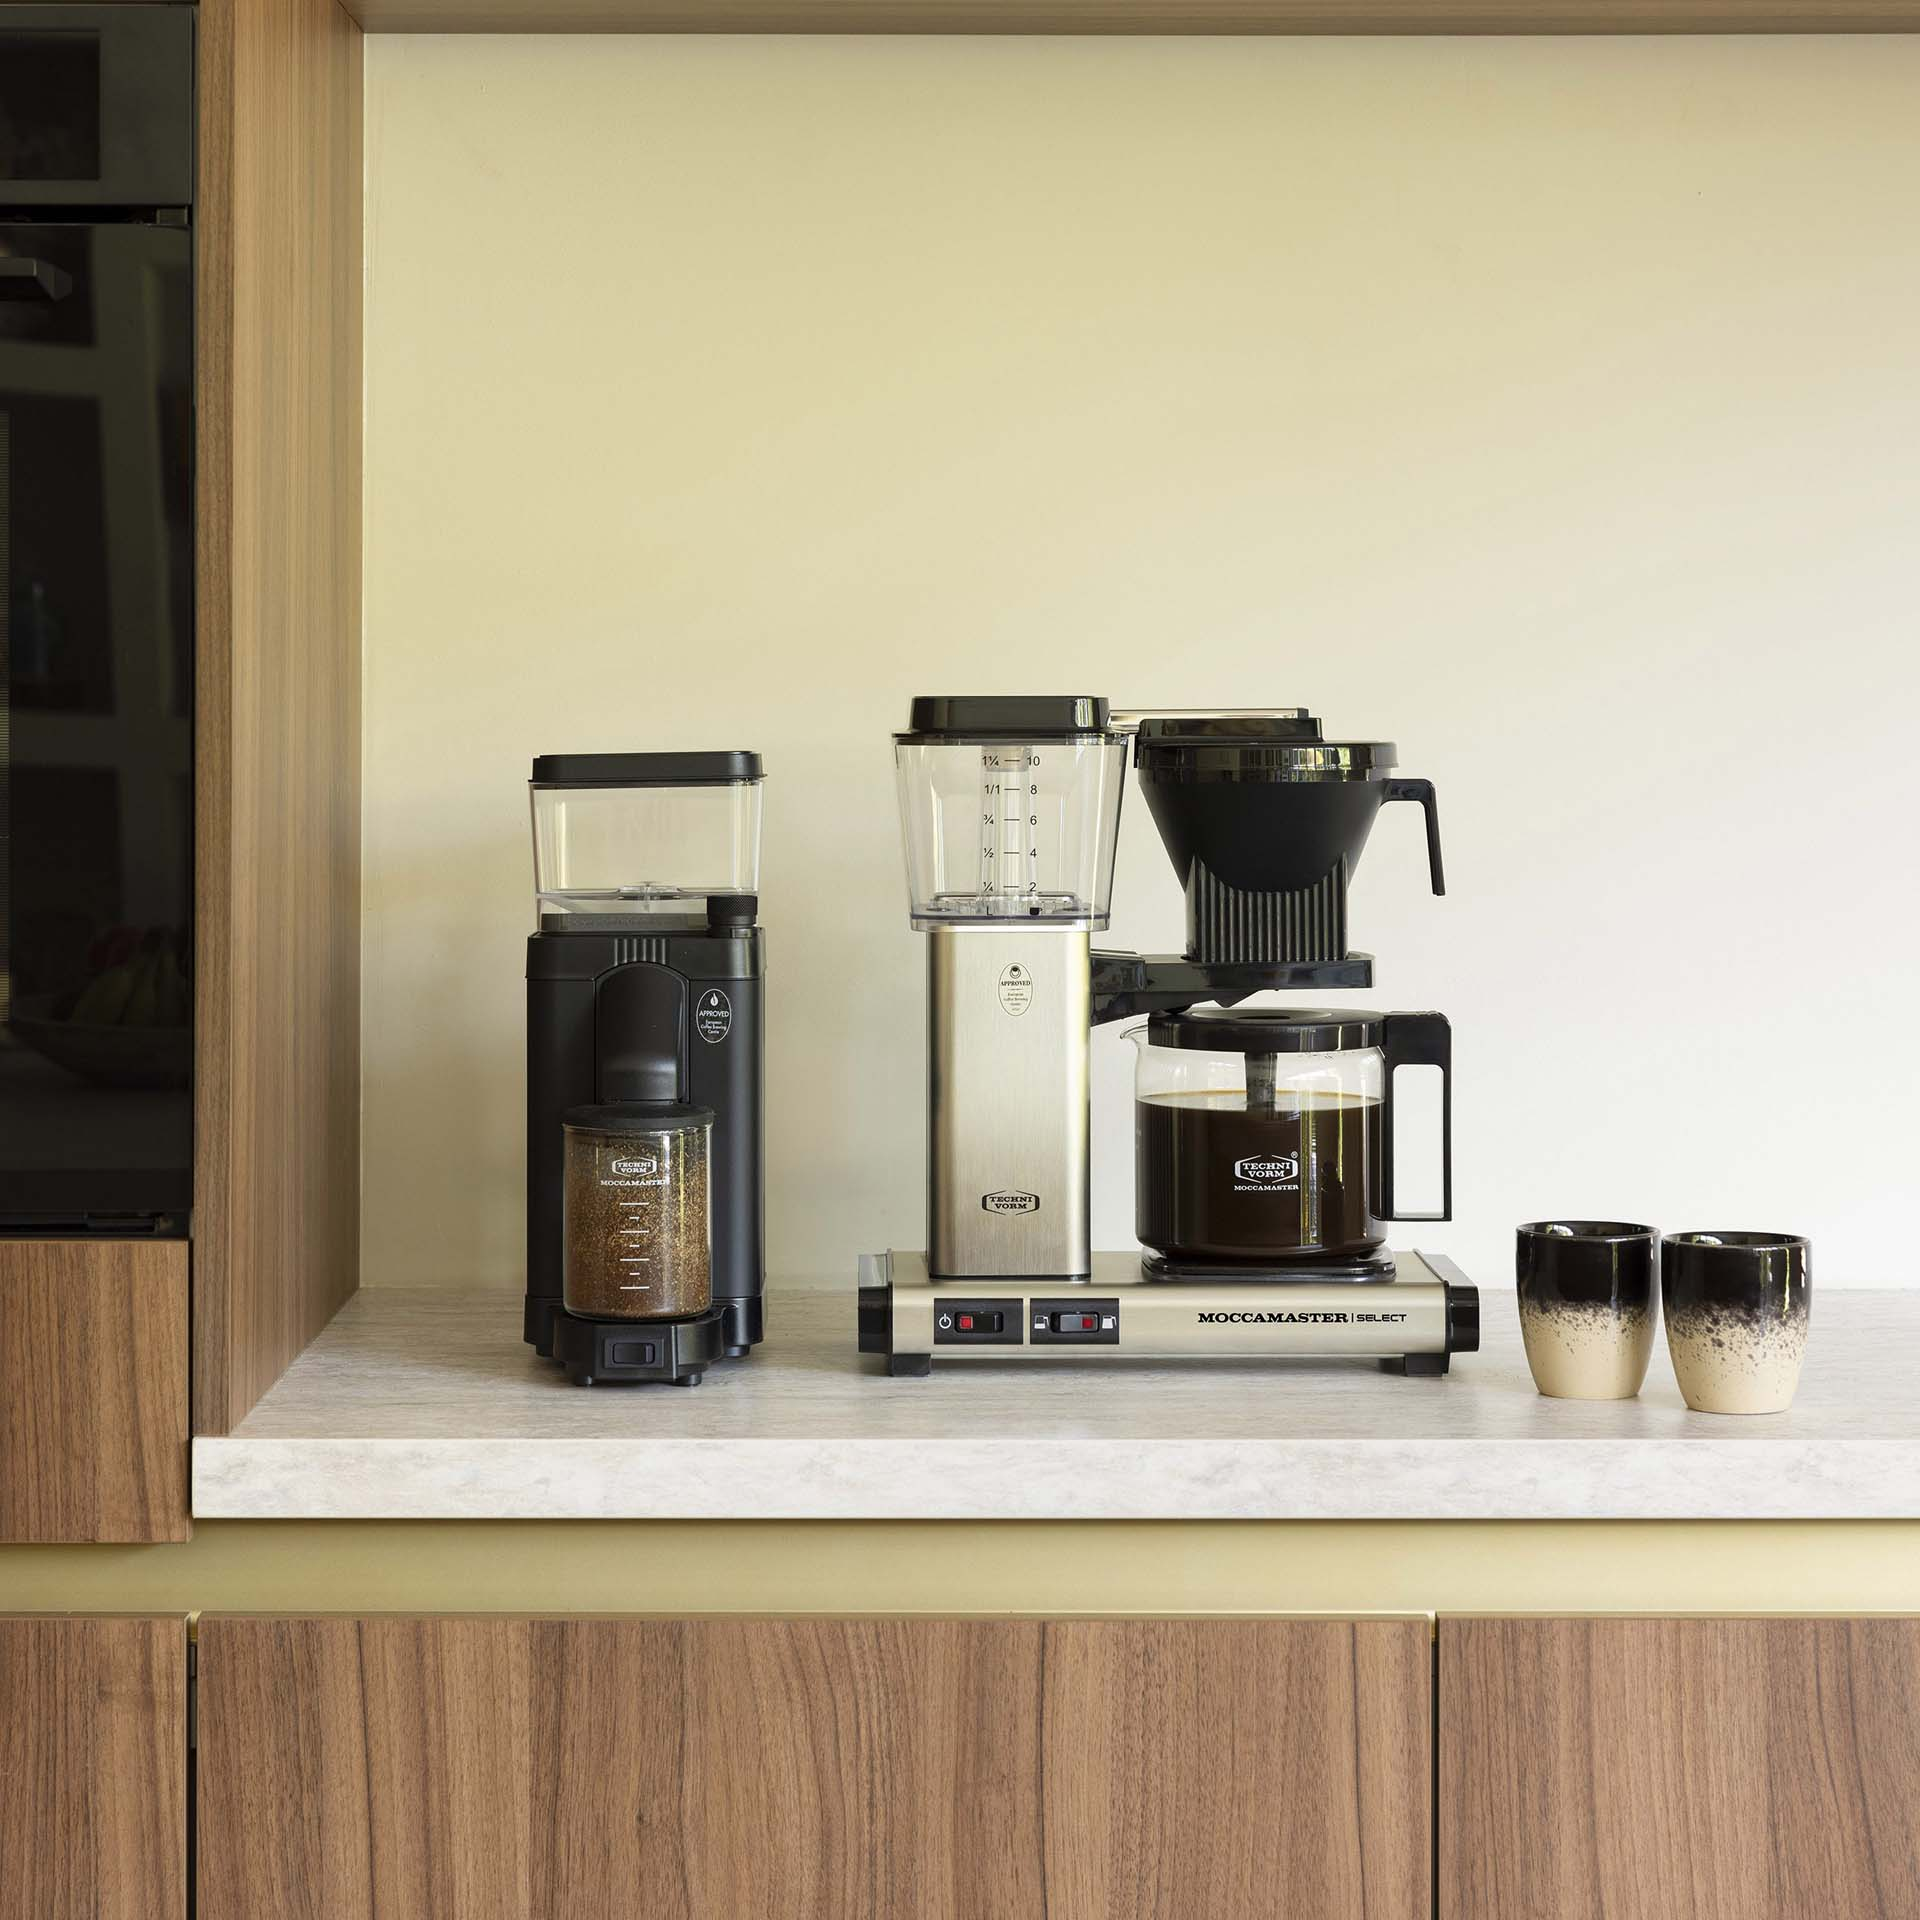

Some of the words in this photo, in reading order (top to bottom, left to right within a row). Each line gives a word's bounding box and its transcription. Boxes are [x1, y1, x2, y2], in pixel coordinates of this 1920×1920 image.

[1027, 755, 1040, 766] 10
[984, 784, 1000, 795] 1/1
[1030, 784, 1037, 795] 8
[1030, 815, 1037, 826] 6
[1029, 848, 1037, 858] 4
[1029, 881, 1037, 892] 2
[699, 1010, 730, 1018] APPROVED
[1242, 1162, 1291, 1170] TECHNI
[1248, 1170, 1285, 1178] VORM
[1198, 1312, 1348, 1324] MOCCAMASTER
[1356, 1313, 1407, 1323] SELECT
